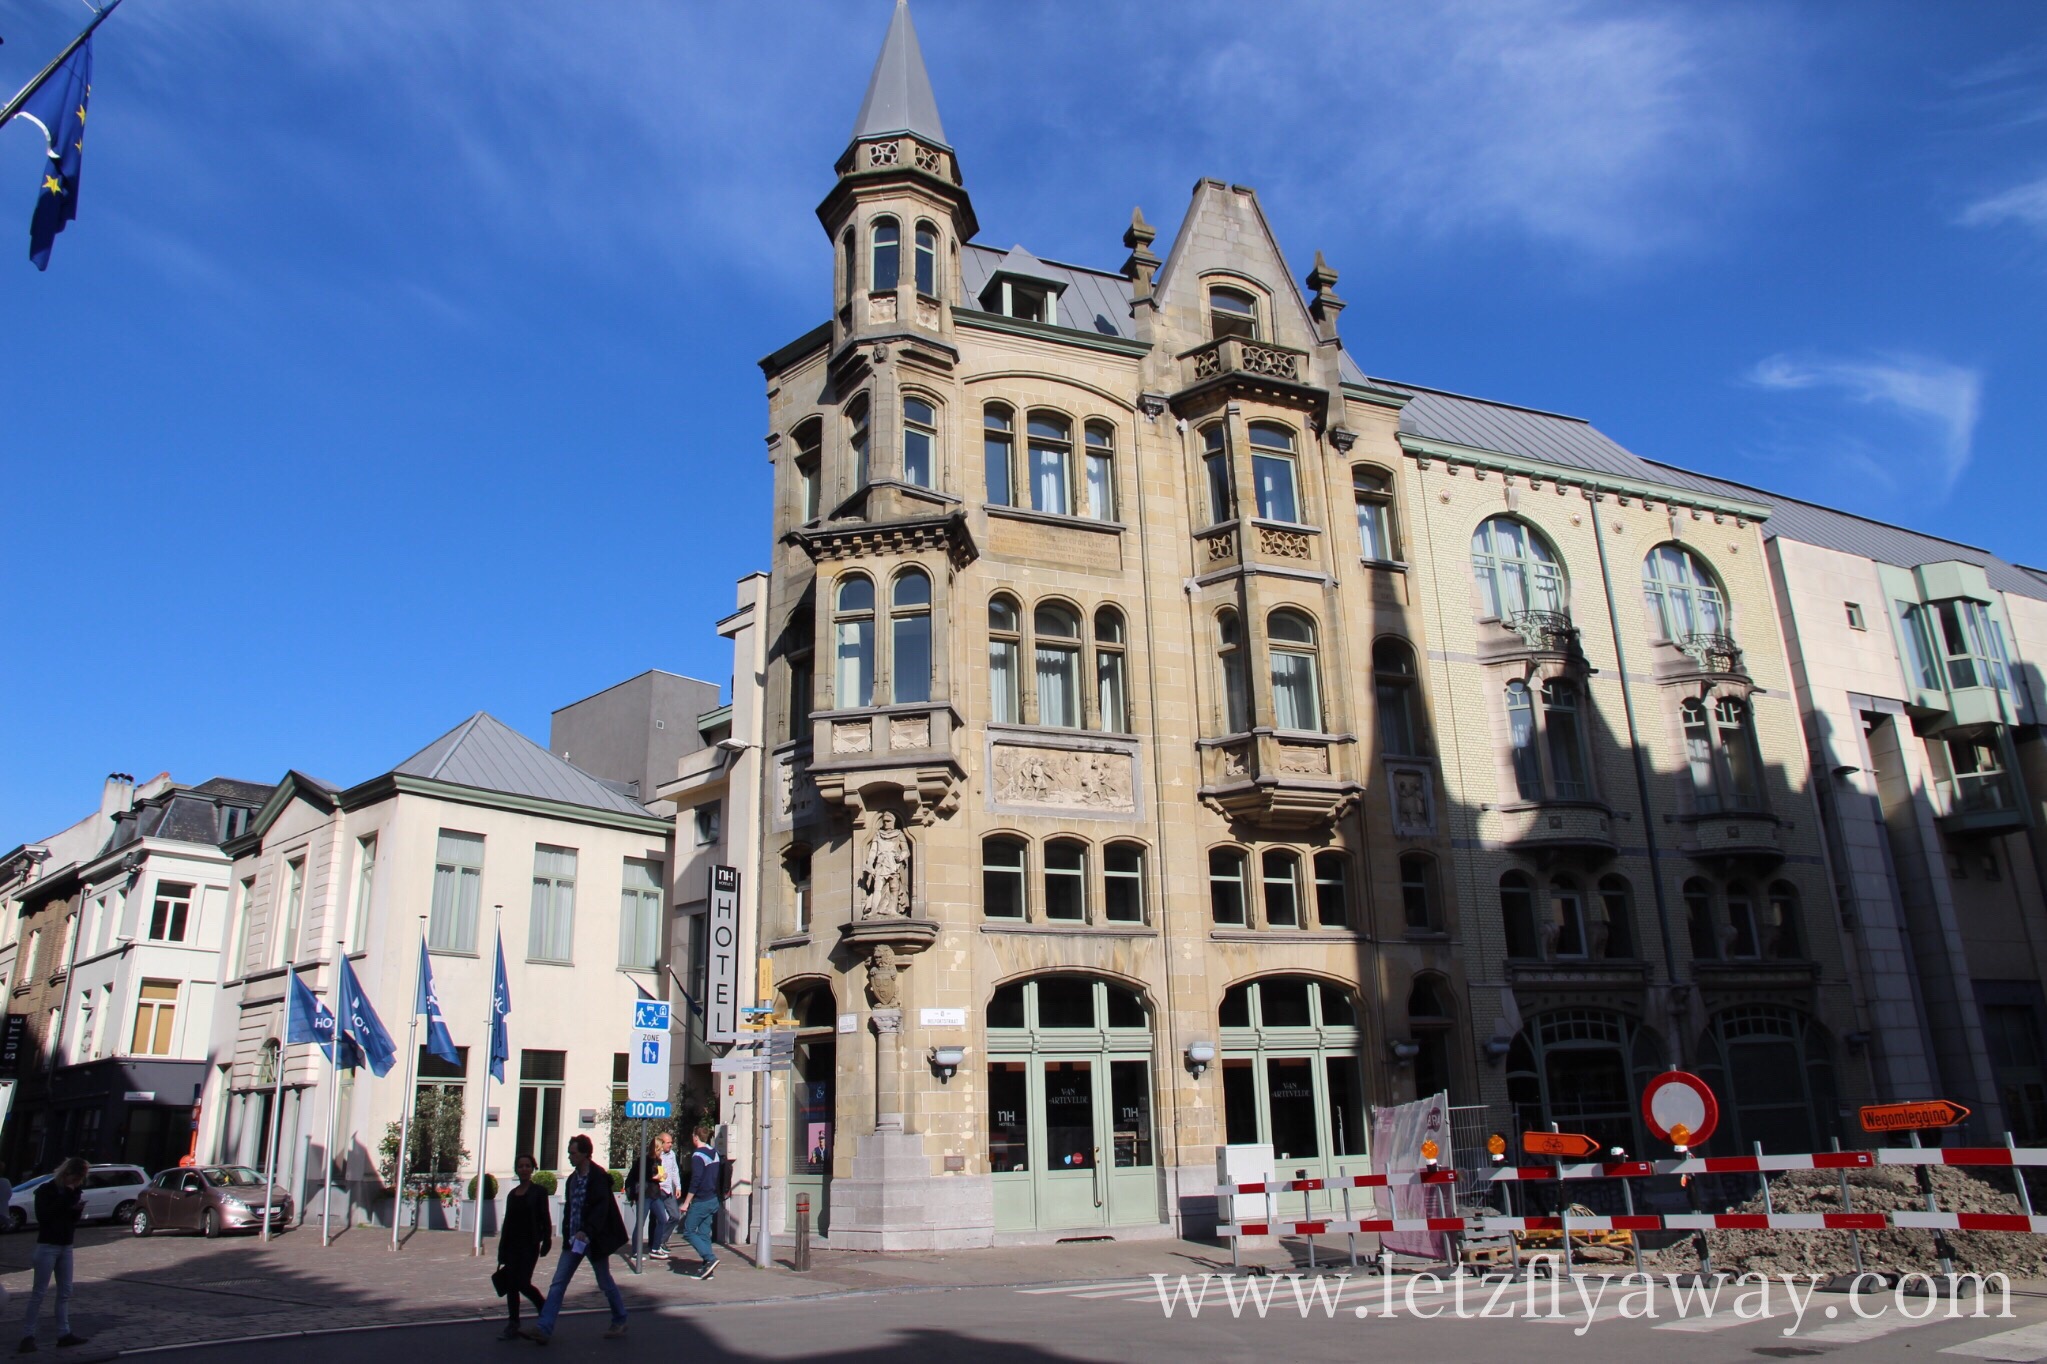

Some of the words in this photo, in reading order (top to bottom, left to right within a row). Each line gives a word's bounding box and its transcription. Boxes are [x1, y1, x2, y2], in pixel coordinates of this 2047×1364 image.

[715, 898, 732, 1033] HOTEL
[4, 1017, 23, 1060] SUITE
[642, 1033, 659, 1042] ZONE
[632, 1102, 665, 1117] 100m
[1863, 1107, 1949, 1129] Wegomlegging
